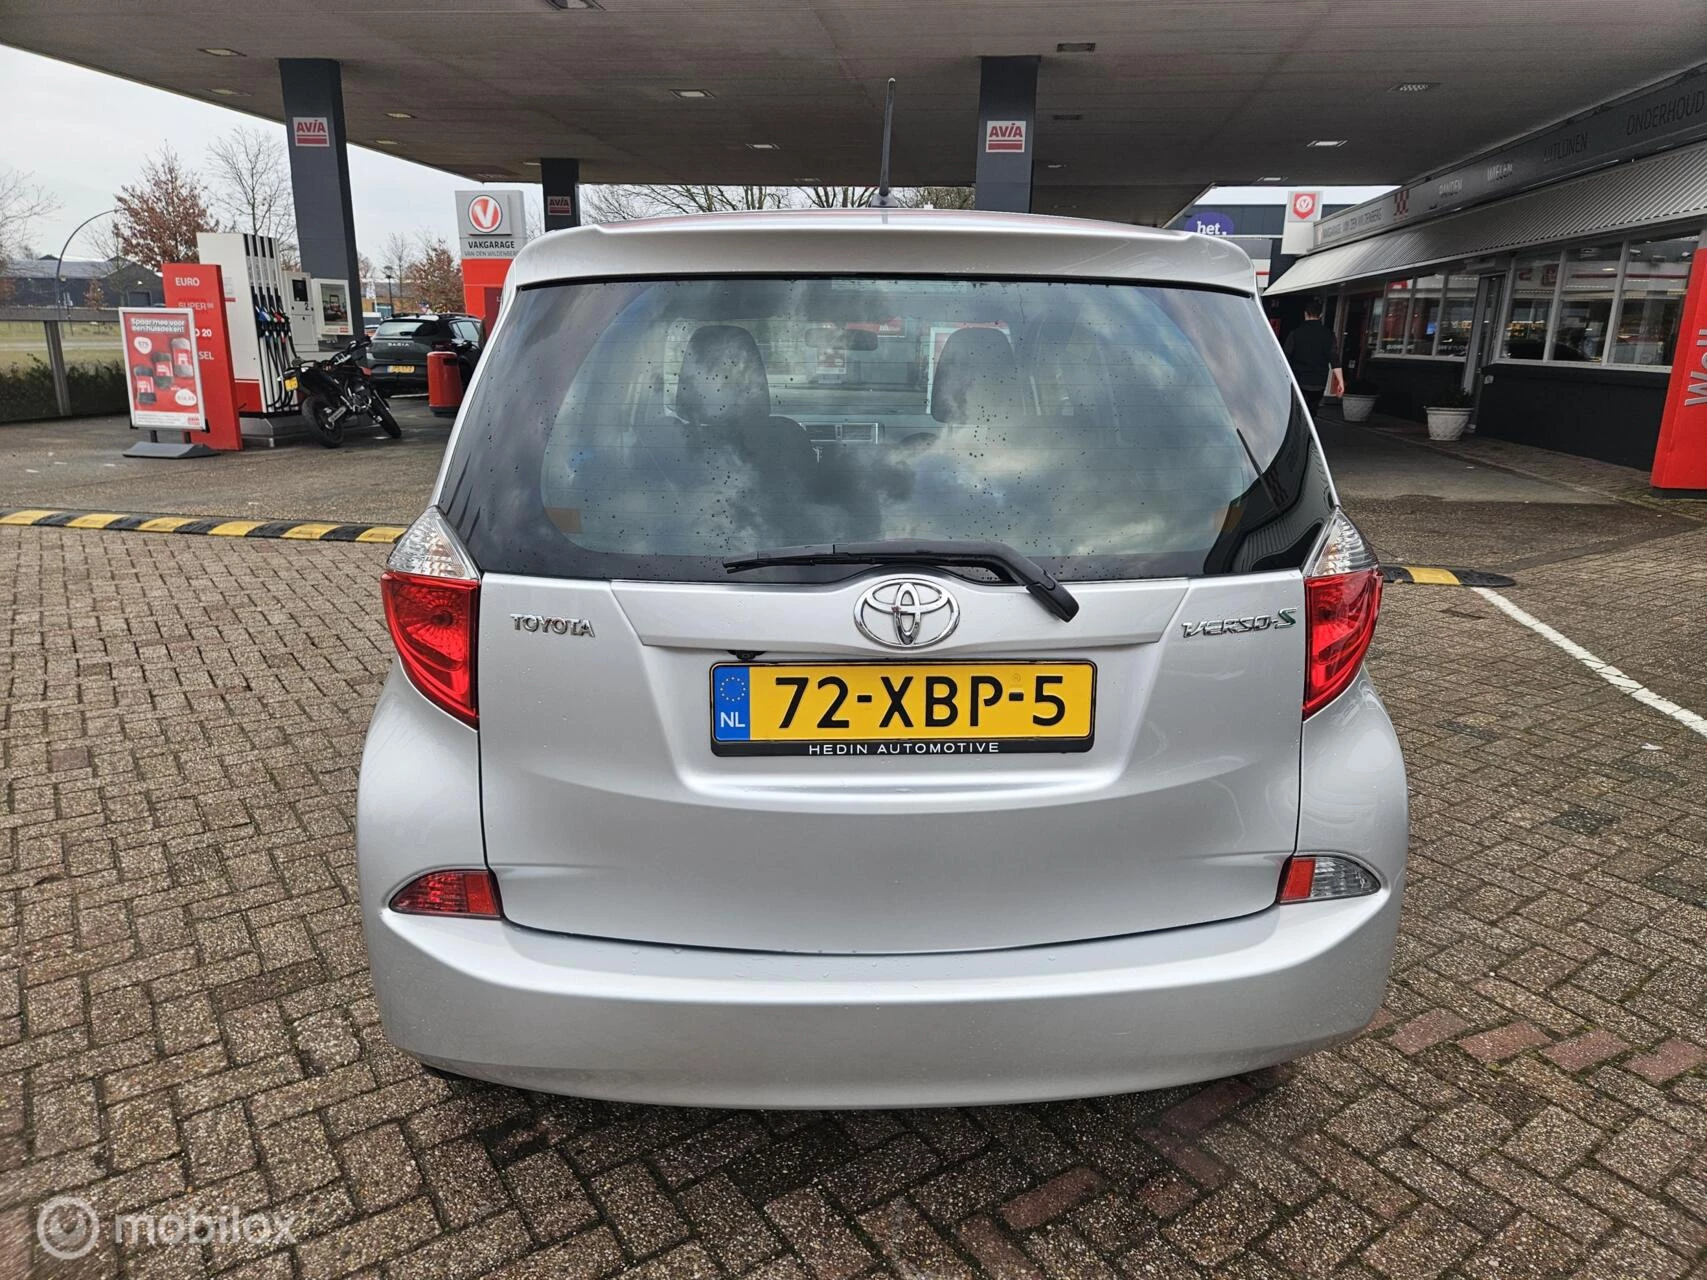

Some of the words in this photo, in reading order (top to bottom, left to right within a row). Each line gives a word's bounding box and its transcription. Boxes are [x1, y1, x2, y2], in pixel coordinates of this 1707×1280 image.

[296, 119, 327, 133] AVIA
[989, 122, 1023, 138] AVIA
[468, 240, 515, 249] VAKGARAGE
[175, 277, 200, 287] EURO
[202, 328, 213, 337] 20
[199, 350, 215, 360] SEL
[510, 613, 596, 638] TOYOTA
[1182, 607, 1298, 640] VERSO-S
[775, 674, 1067, 729] 72-XBP-5
[720, 711, 745, 728] NL
[809, 742, 868, 755] HEDIN
[876, 742, 1000, 755] AUTOMOTIVE
